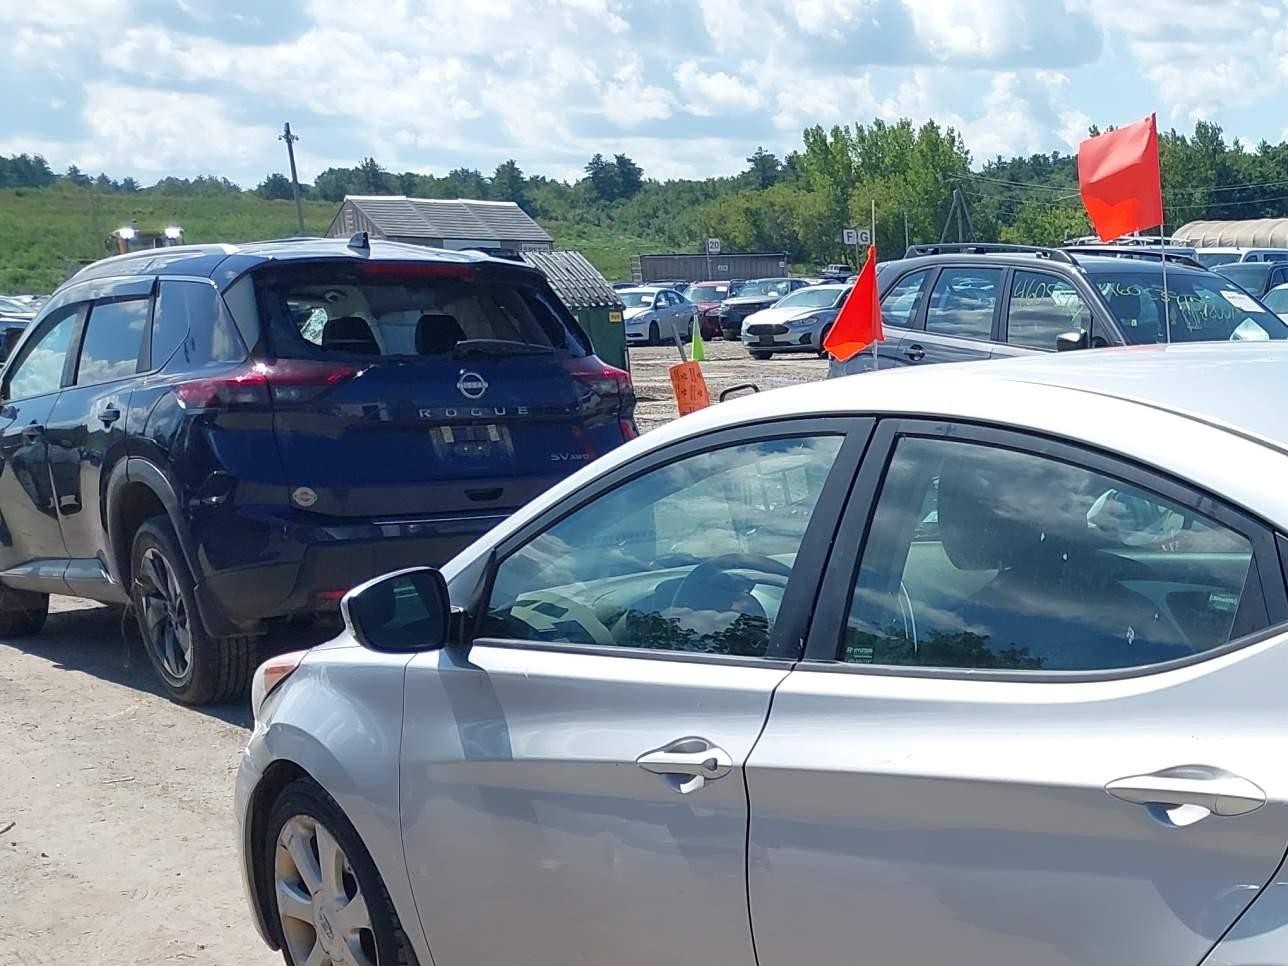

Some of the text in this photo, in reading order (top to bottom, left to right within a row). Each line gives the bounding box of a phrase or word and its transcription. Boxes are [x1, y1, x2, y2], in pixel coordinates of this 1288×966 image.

[847, 232, 853, 242] F
[860, 232, 869, 242] G
[709, 241, 719, 250] 20
[419, 406, 529, 418] ROGUE
